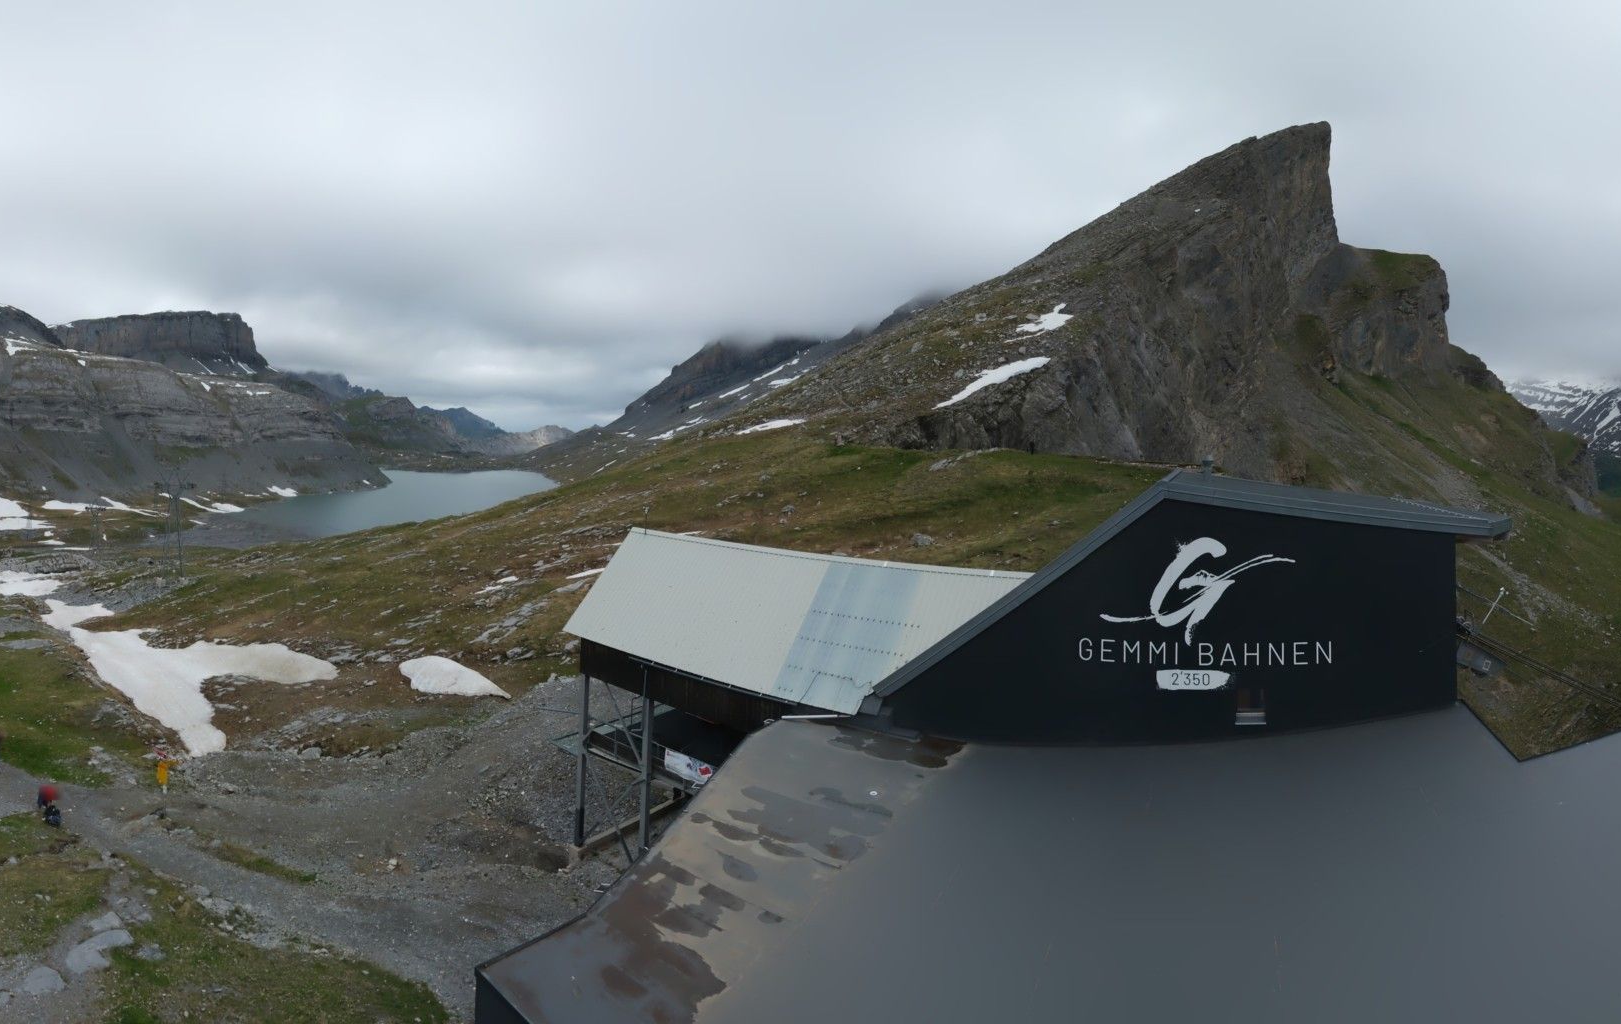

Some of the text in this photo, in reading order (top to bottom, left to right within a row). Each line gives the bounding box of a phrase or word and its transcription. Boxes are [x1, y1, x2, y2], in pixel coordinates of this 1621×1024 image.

[1078, 637, 1333, 667] GEMMI BAHNEN
[1170, 670, 1211, 687] 2'350
